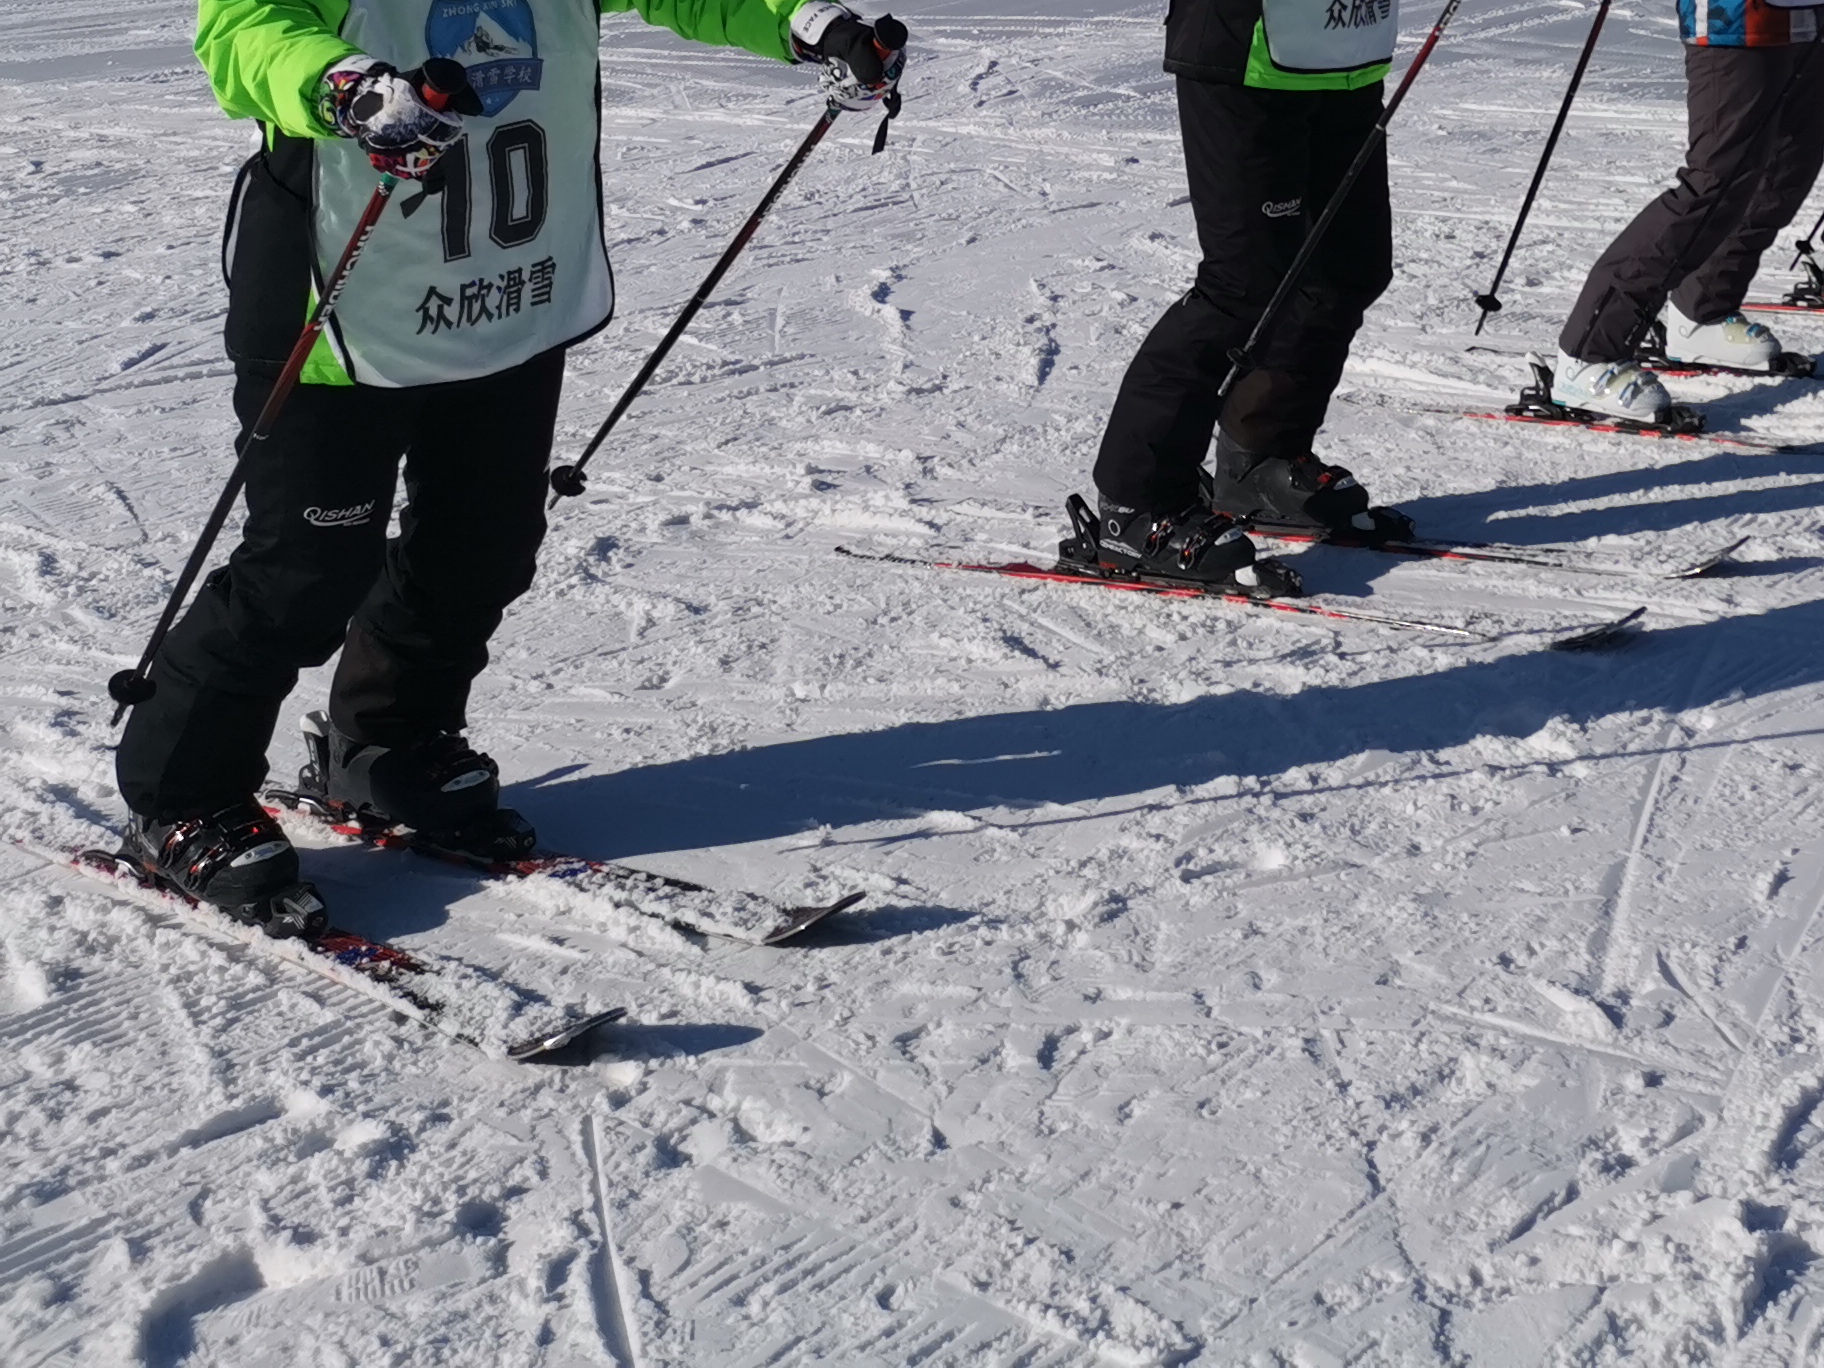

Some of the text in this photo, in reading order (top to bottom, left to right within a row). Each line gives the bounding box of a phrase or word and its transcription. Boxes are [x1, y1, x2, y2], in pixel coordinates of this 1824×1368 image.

[442, 2, 480, 18] ZHONG
[441, 118, 549, 264] 10
[414, 255, 558, 335] 众欣滑雪
[303, 499, 376, 527] QISHAN
